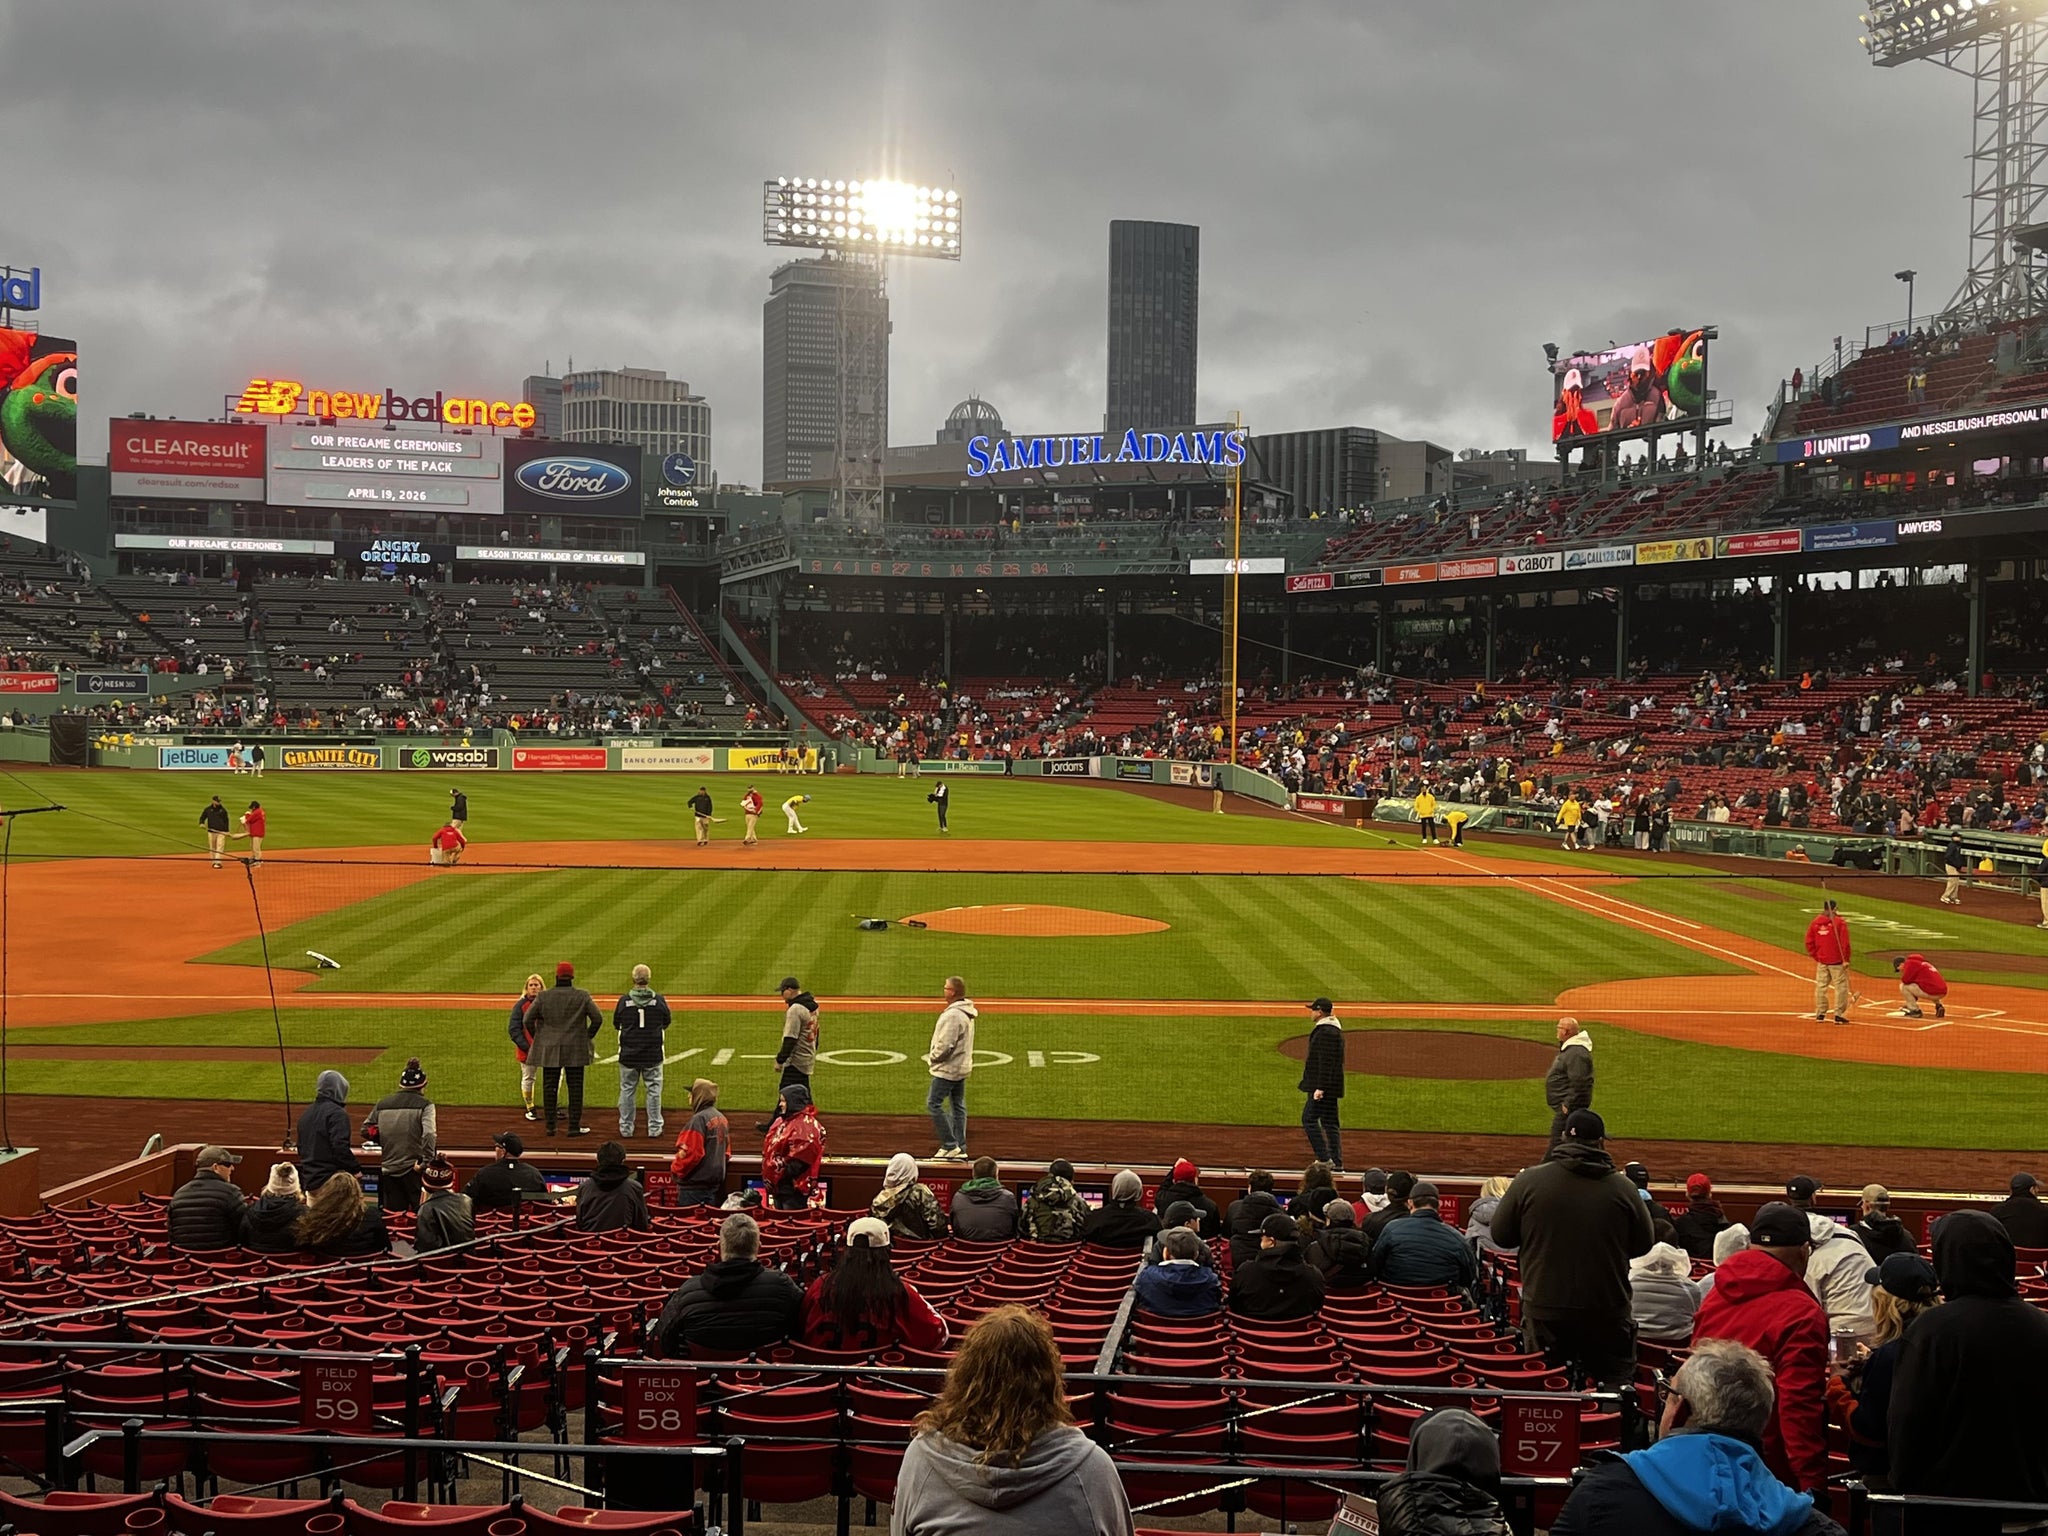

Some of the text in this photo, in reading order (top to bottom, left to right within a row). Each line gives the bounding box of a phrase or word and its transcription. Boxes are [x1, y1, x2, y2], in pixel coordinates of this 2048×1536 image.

[0, 268, 40, 309] al
[307, 390, 382, 419] new
[386, 388, 536, 428] balance
[1901, 425, 1920, 439] AND
[127, 438, 248, 458] CLEAResult
[311, 435, 462, 453] OUR PREGAME CEREMONIES
[1818, 433, 1871, 455] UNITED
[966, 427, 1247, 477] SAMUEL ADAMS
[141, 458, 163, 466] change
[176, 459, 188, 467] way
[189, 460, 211, 468] people
[322, 456, 453, 473] LEADERS OF THE PACK
[137, 477, 240, 490] clearesult.com/redsox
[537, 462, 608, 493] Ford
[348, 488, 427, 502] APRIL 19, 2026
[658, 488, 693, 497] Johnson
[663, 497, 699, 507] Controls
[1898, 520, 1942, 535] LAWYERS
[168, 538, 283, 551] OUR PREGAME CEREMONIES
[371, 540, 420, 552] ANGRY
[360, 551, 431, 564] ORCHARD
[478, 550, 625, 563] SEASON TICKET HOLDER OF THE GAME
[1587, 548, 1632, 564] CALL128.COM
[833, 560, 842, 573] 4
[854, 561, 860, 574] 1
[1060, 563, 1075, 576] 42
[1399, 568, 1421, 580] STIHL
[1307, 577, 1326, 589] PIZZA
[21, 677, 57, 690] TICKET
[104, 680, 124, 688] NESN
[166, 749, 219, 767] jetBlue
[284, 750, 344, 765] GRANITE
[348, 749, 379, 769] CITY
[432, 749, 488, 763] wasabi
[637, 1008, 646, 1028] 1
[315, 1367, 358, 1380] FIELD
[321, 1381, 352, 1392] BOX
[638, 1377, 681, 1390] FIELD
[644, 1390, 676, 1402] BOX
[315, 1399, 359, 1421] 59
[1517, 1407, 1563, 1421] FIELD
[636, 1408, 682, 1431] 58
[1524, 1421, 1557, 1433] BOX
[1516, 1440, 1562, 1463] 57
[1343, 1511, 1378, 1533] BOSTON
